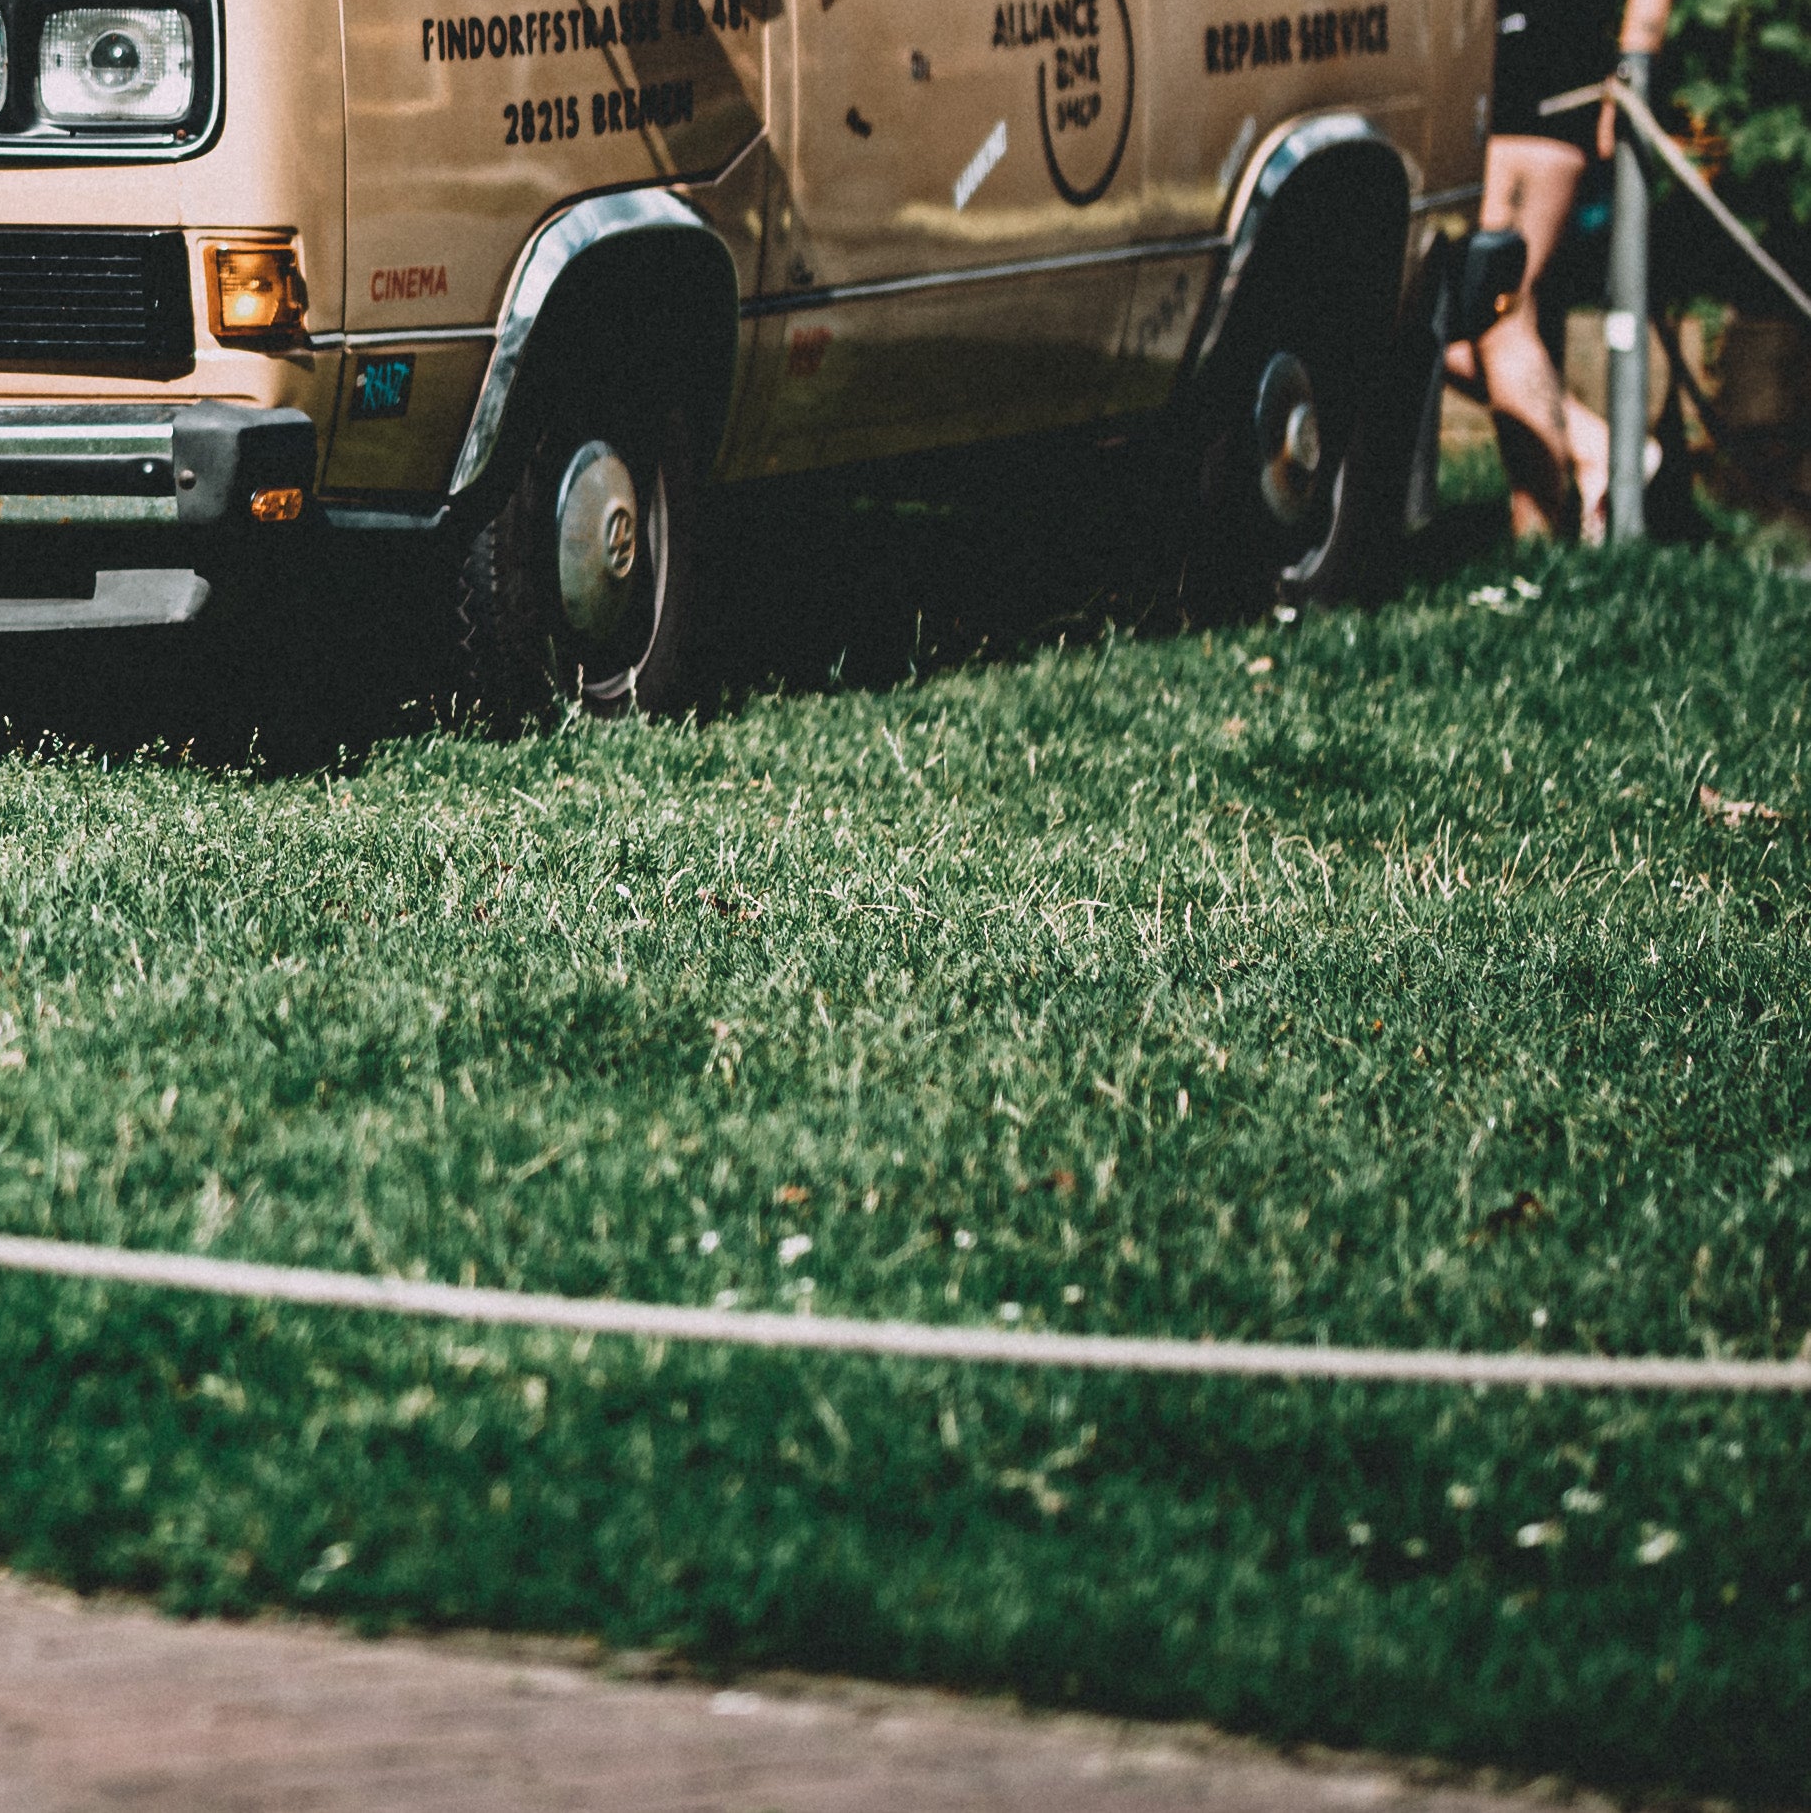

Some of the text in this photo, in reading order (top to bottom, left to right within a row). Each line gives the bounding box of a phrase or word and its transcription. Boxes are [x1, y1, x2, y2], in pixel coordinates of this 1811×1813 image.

[1205, 2, 1390, 75] REPAIR SERVICE
[1056, 45, 1101, 91] BMX
[503, 81, 695, 146] 28215 BREMEN
[370, 265, 448, 303] CINEMA
